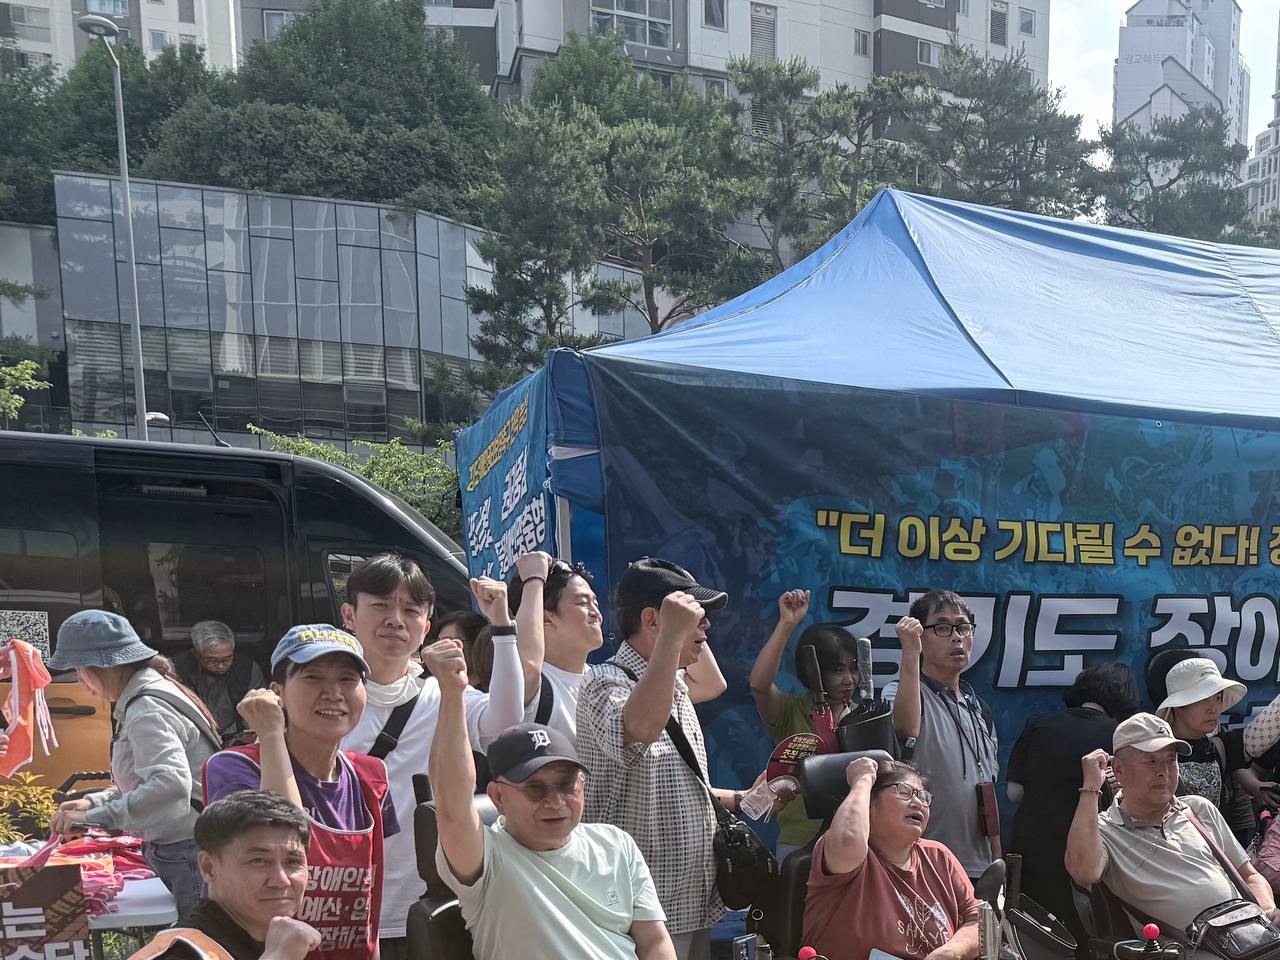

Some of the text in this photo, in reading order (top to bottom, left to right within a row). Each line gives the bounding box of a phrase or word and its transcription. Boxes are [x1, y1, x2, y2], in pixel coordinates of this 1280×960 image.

[816, 510, 885, 558] "더
[898, 515, 986, 562] 이상
[995, 520, 1115, 566] 기다릴
[1123, 523, 1161, 566] 수
[1171, 524, 1259, 567] 없다!
[528, 729, 552, 751] D
